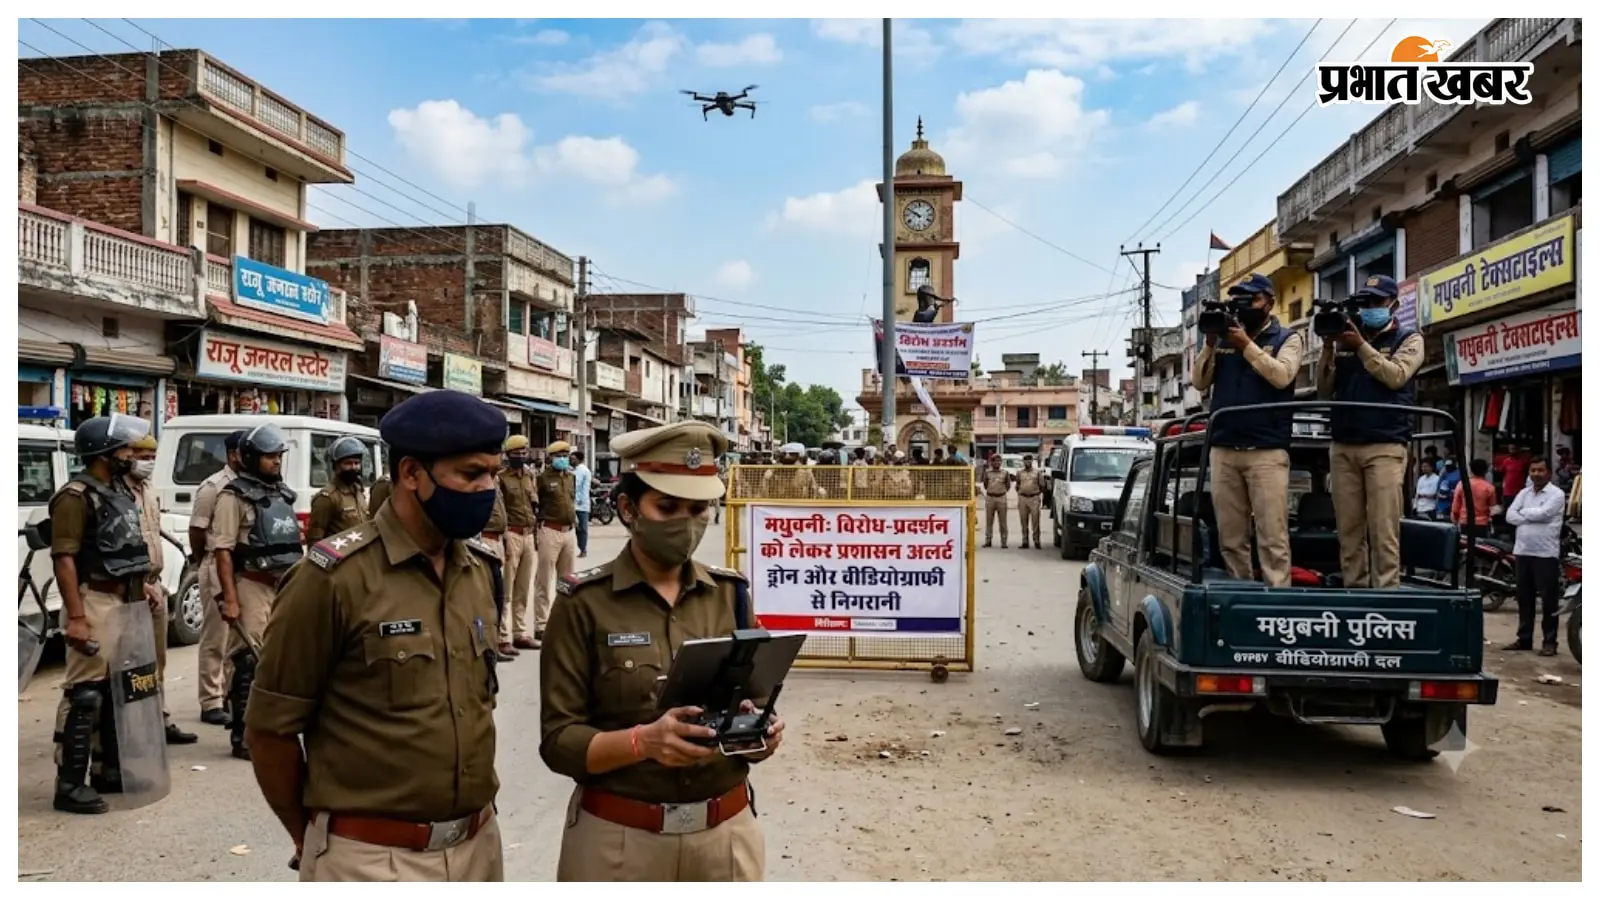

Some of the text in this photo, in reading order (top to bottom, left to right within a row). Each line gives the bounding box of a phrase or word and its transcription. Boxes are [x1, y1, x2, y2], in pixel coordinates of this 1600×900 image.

[206, 339, 242, 374] राजू
[243, 344, 294, 372] जनरल
[297, 350, 329, 377] स्टोर
[837, 513, 950, 536] विरोध-प्रदर्शन
[761, 538, 954, 560] को लेकर प्रशासन अलर्ट
[767, 564, 945, 588] ड्रोन और वीडियोग्राफी
[811, 589, 901, 611] से निगरानी
[1256, 611, 1417, 646] मधुबनी पुलिस
[1375, 655, 1402, 668] दल
